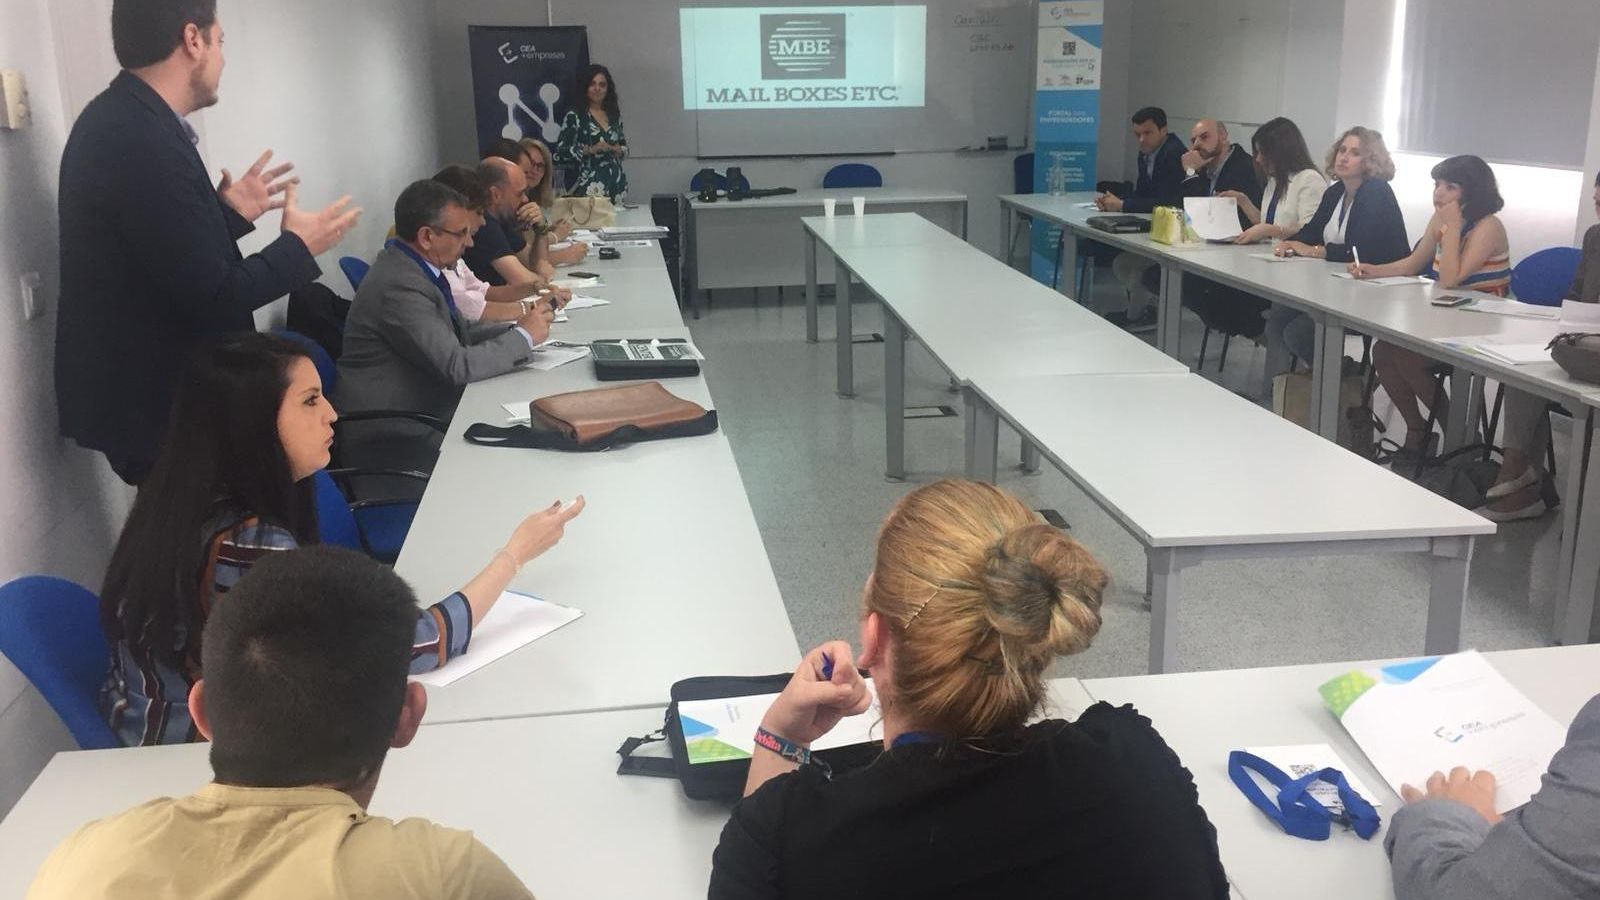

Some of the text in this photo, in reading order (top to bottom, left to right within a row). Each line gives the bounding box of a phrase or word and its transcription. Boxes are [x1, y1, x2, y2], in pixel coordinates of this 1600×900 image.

[777, 39, 830, 55] MBE
[706, 87, 770, 103] MAIL
[774, 86, 847, 102] BOXES
